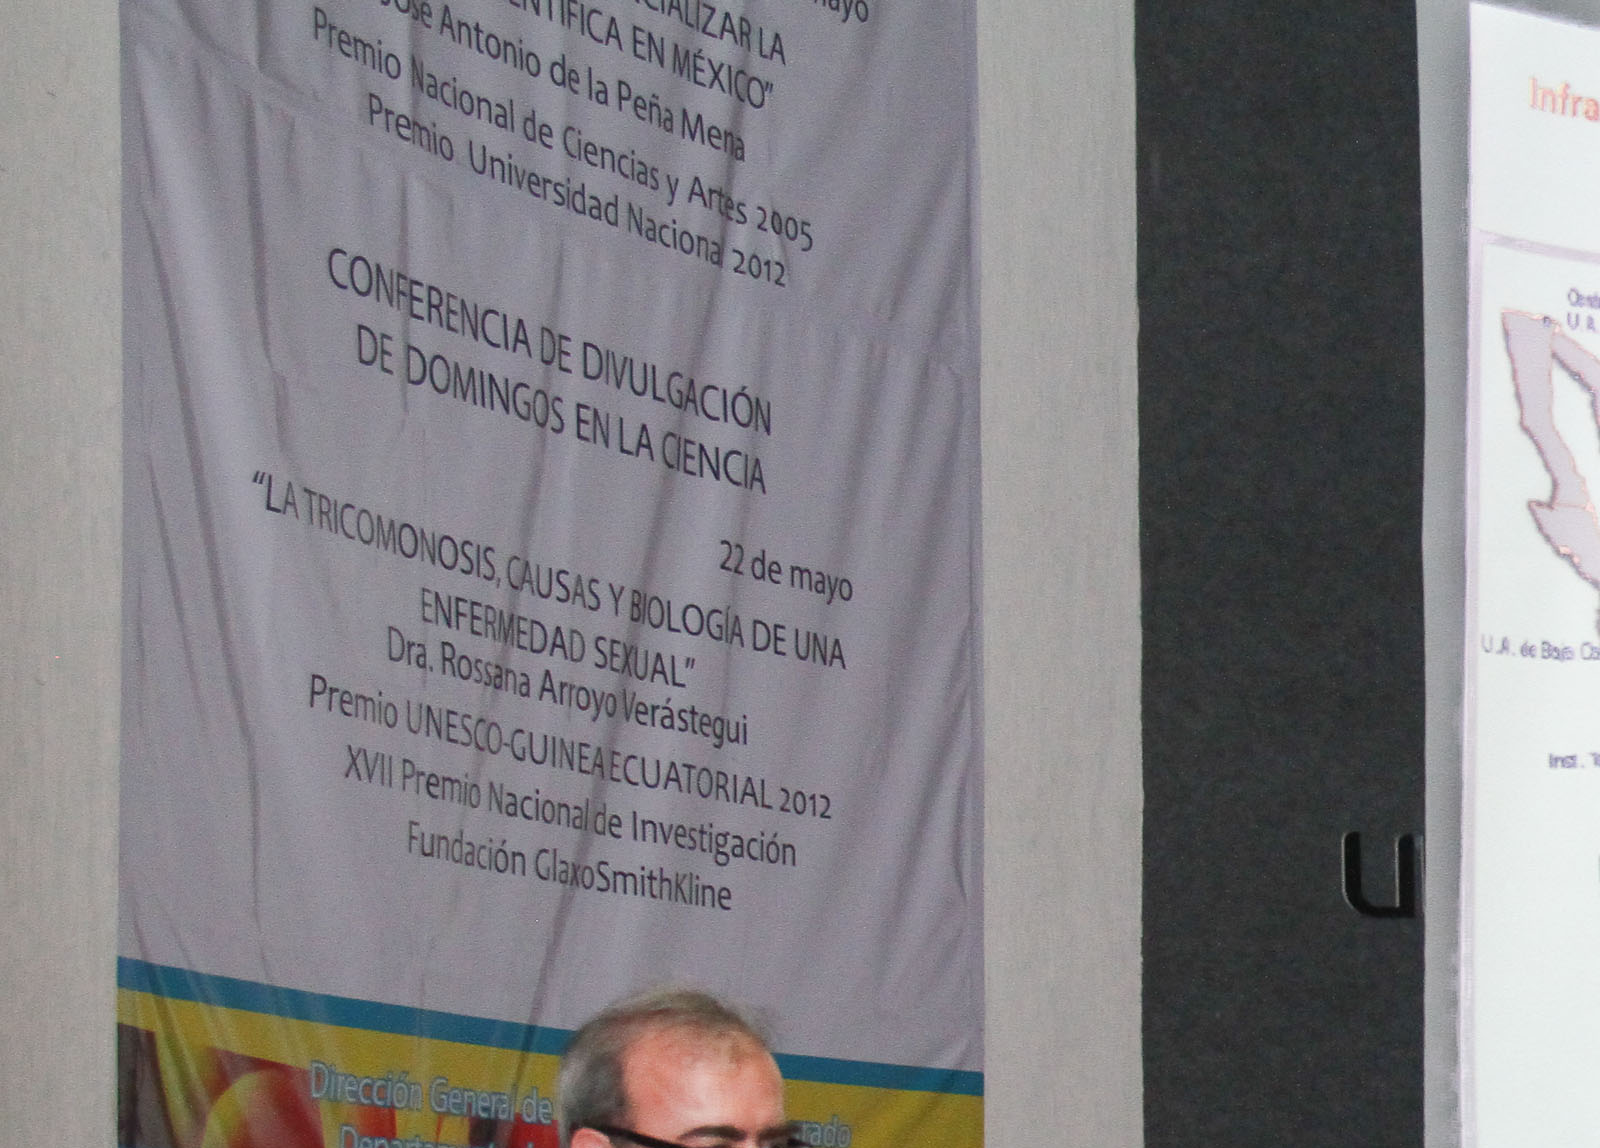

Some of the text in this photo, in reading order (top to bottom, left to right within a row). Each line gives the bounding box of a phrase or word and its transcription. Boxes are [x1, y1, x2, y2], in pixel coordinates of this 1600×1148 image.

[632, 25, 664, 68] EN
[759, 27, 786, 65] LA
[814, 0, 869, 23] ayo
[314, 7, 814, 252] Premio Nacional de Ciencias y Artes 2005
[440, 4, 541, 78] Antonio
[550, 53, 580, 95] de
[588, 66, 609, 107] la
[617, 80, 674, 134] Peña
[681, 108, 745, 162] Mena
[368, 93, 454, 162] Premio
[467, 140, 619, 229] Universidad
[732, 249, 786, 289] 2012
[329, 247, 772, 437] CONFERENCIA DE DIVULGACIÓN
[357, 324, 767, 495] DE DOMINGOS EN LA CIENCIA
[302, 485, 502, 588] TRICOMONOSIS,
[506, 554, 601, 612] CAUSAS
[609, 583, 626, 618] Y
[630, 590, 746, 648] BIOLOGÍA
[753, 620, 787, 658] DE
[795, 628, 848, 671] UNA
[420, 587, 586, 664] ENFERMEDAD
[719, 540, 853, 605] 22 de mayo
[309, 674, 832, 820] Premio UNESCO-GUINEA ECUATORIAL 2012
[388, 625, 748, 748] Dra. Rossana Arroyo Verástegui
[344, 744, 797, 867] XVII Premio Nacional de Investigación
[408, 820, 733, 912] Fundación GlaxoSmithKline
[309, 1059, 422, 1112] Dirección
[429, 1077, 516, 1123] General
[521, 1090, 554, 1125] de
